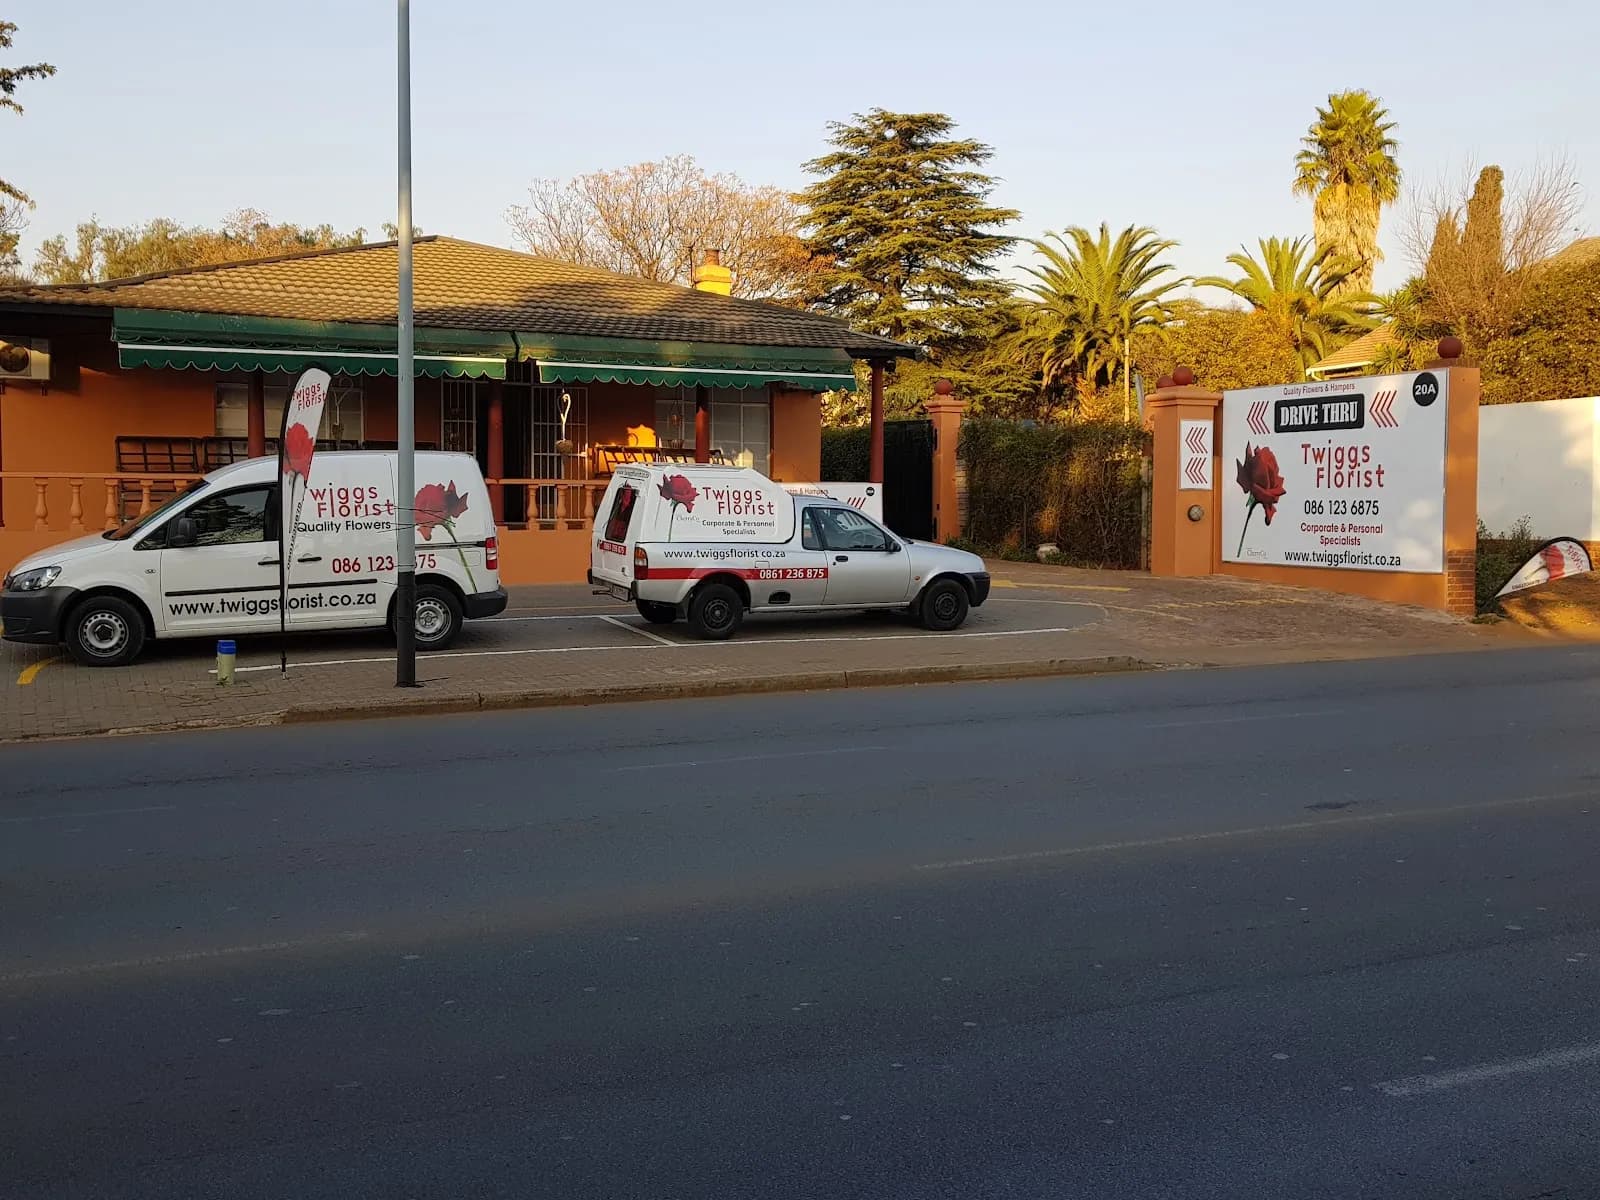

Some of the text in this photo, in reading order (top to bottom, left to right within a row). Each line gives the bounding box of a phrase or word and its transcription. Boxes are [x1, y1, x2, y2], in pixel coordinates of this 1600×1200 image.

[1325, 384, 1329, 392] &
[1331, 383, 1355, 392] Hampers
[1415, 384, 1436, 395] 20A
[1280, 401, 1359, 426] DRIVE THRU
[1301, 439, 1370, 470] Twiggs
[1316, 464, 1385, 488] Florist
[310, 482, 378, 504] wiggs
[702, 485, 762, 504] Twiggs
[317, 499, 394, 518] Florist
[718, 501, 775, 515] Florist
[1304, 500, 1379, 515] 086 123 6875
[297, 520, 391, 533] Quality Flowers
[1300, 522, 1383, 534] Corporate & Personal
[1320, 535, 1361, 546] Specialists
[664, 549, 786, 560] www.twiggsfloristco.za
[1285, 550, 1401, 567] www.twiggsflorist.co.za
[332, 557, 361, 573] 086
[367, 555, 394, 572] 123
[759, 568, 824, 579] 0861 236 875
